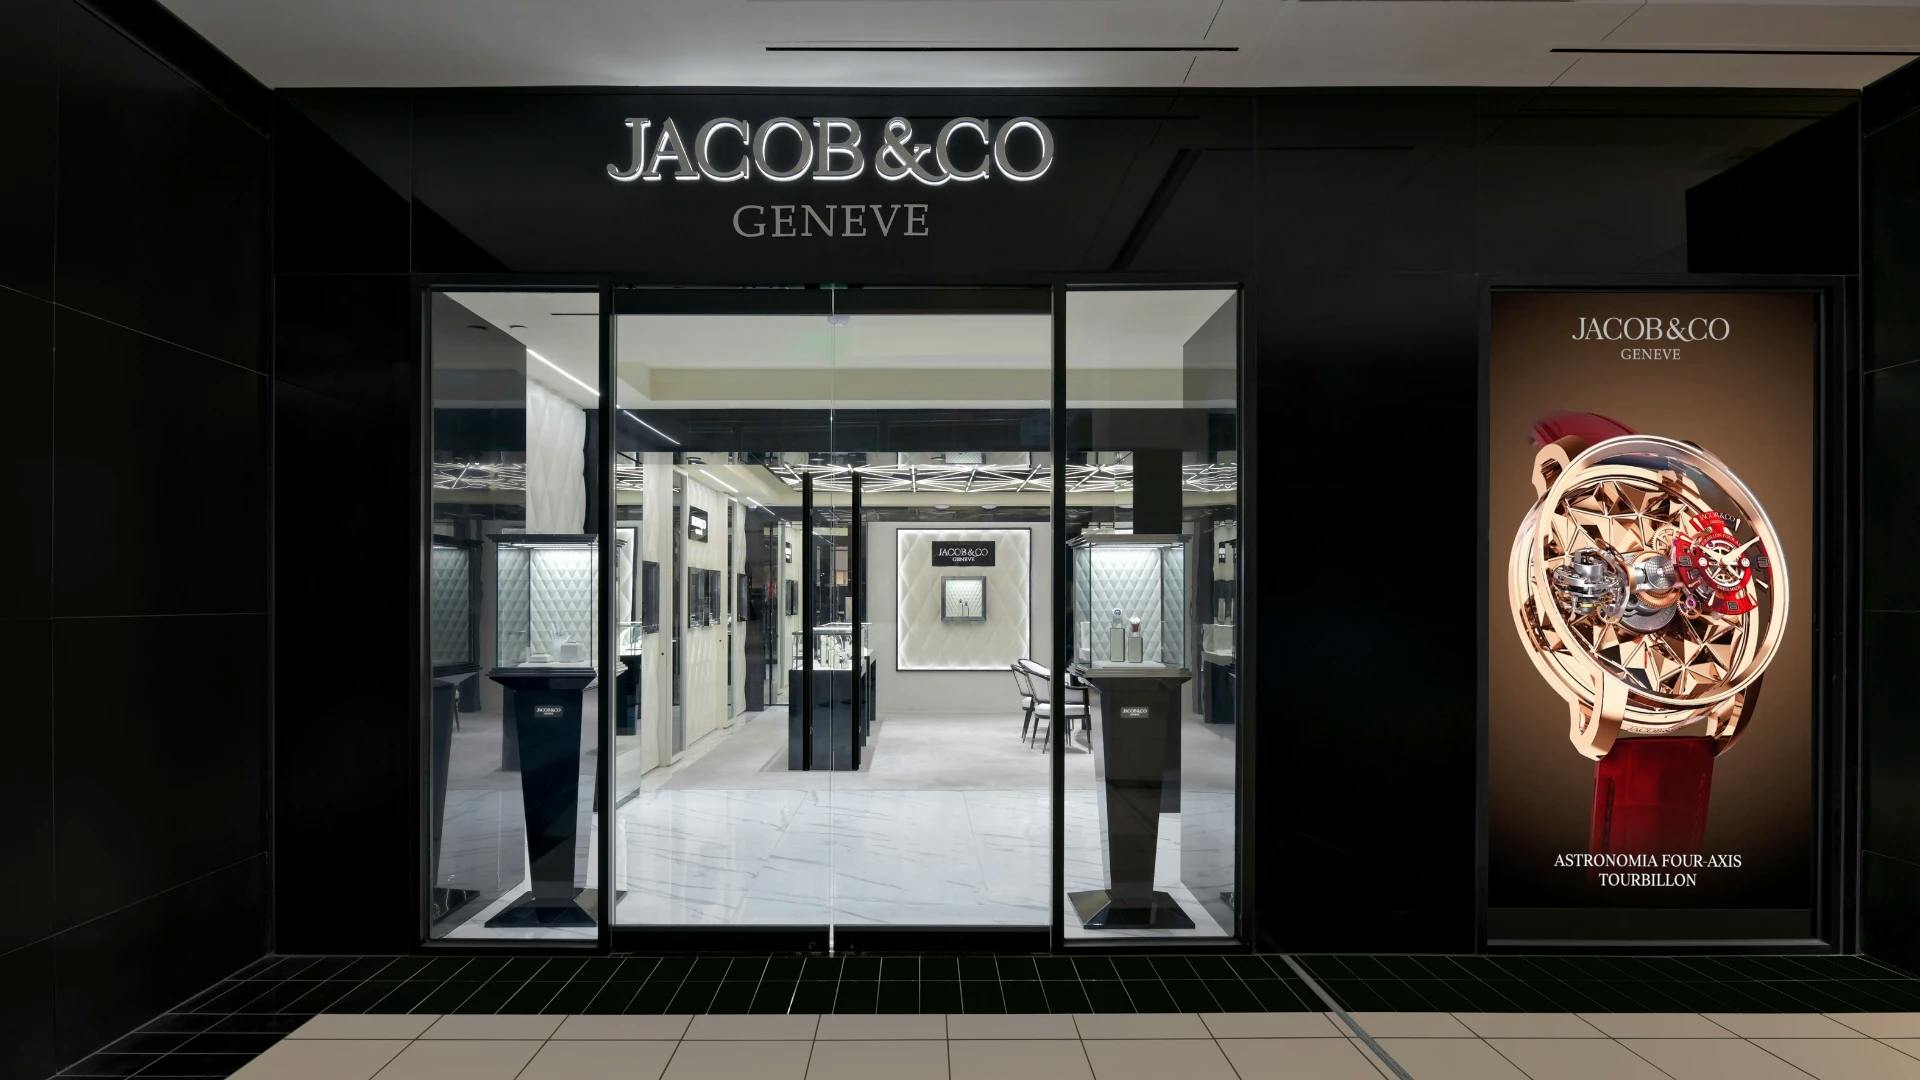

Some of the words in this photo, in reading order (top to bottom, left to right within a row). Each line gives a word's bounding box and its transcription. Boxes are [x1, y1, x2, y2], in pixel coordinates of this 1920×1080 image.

[607, 116, 1054, 186] JACOB&CO
[732, 204, 929, 238] GENEVE
[1572, 317, 1730, 342] JACOB&CO
[1620, 348, 1681, 360] GENEVE
[938, 547, 989, 557] JACOB&CO
[1553, 853, 1659, 868] ASTRONOMIA
[1661, 854, 1743, 868] FOUR-AXIS
[1598, 873, 1697, 887] TOURBILLON
